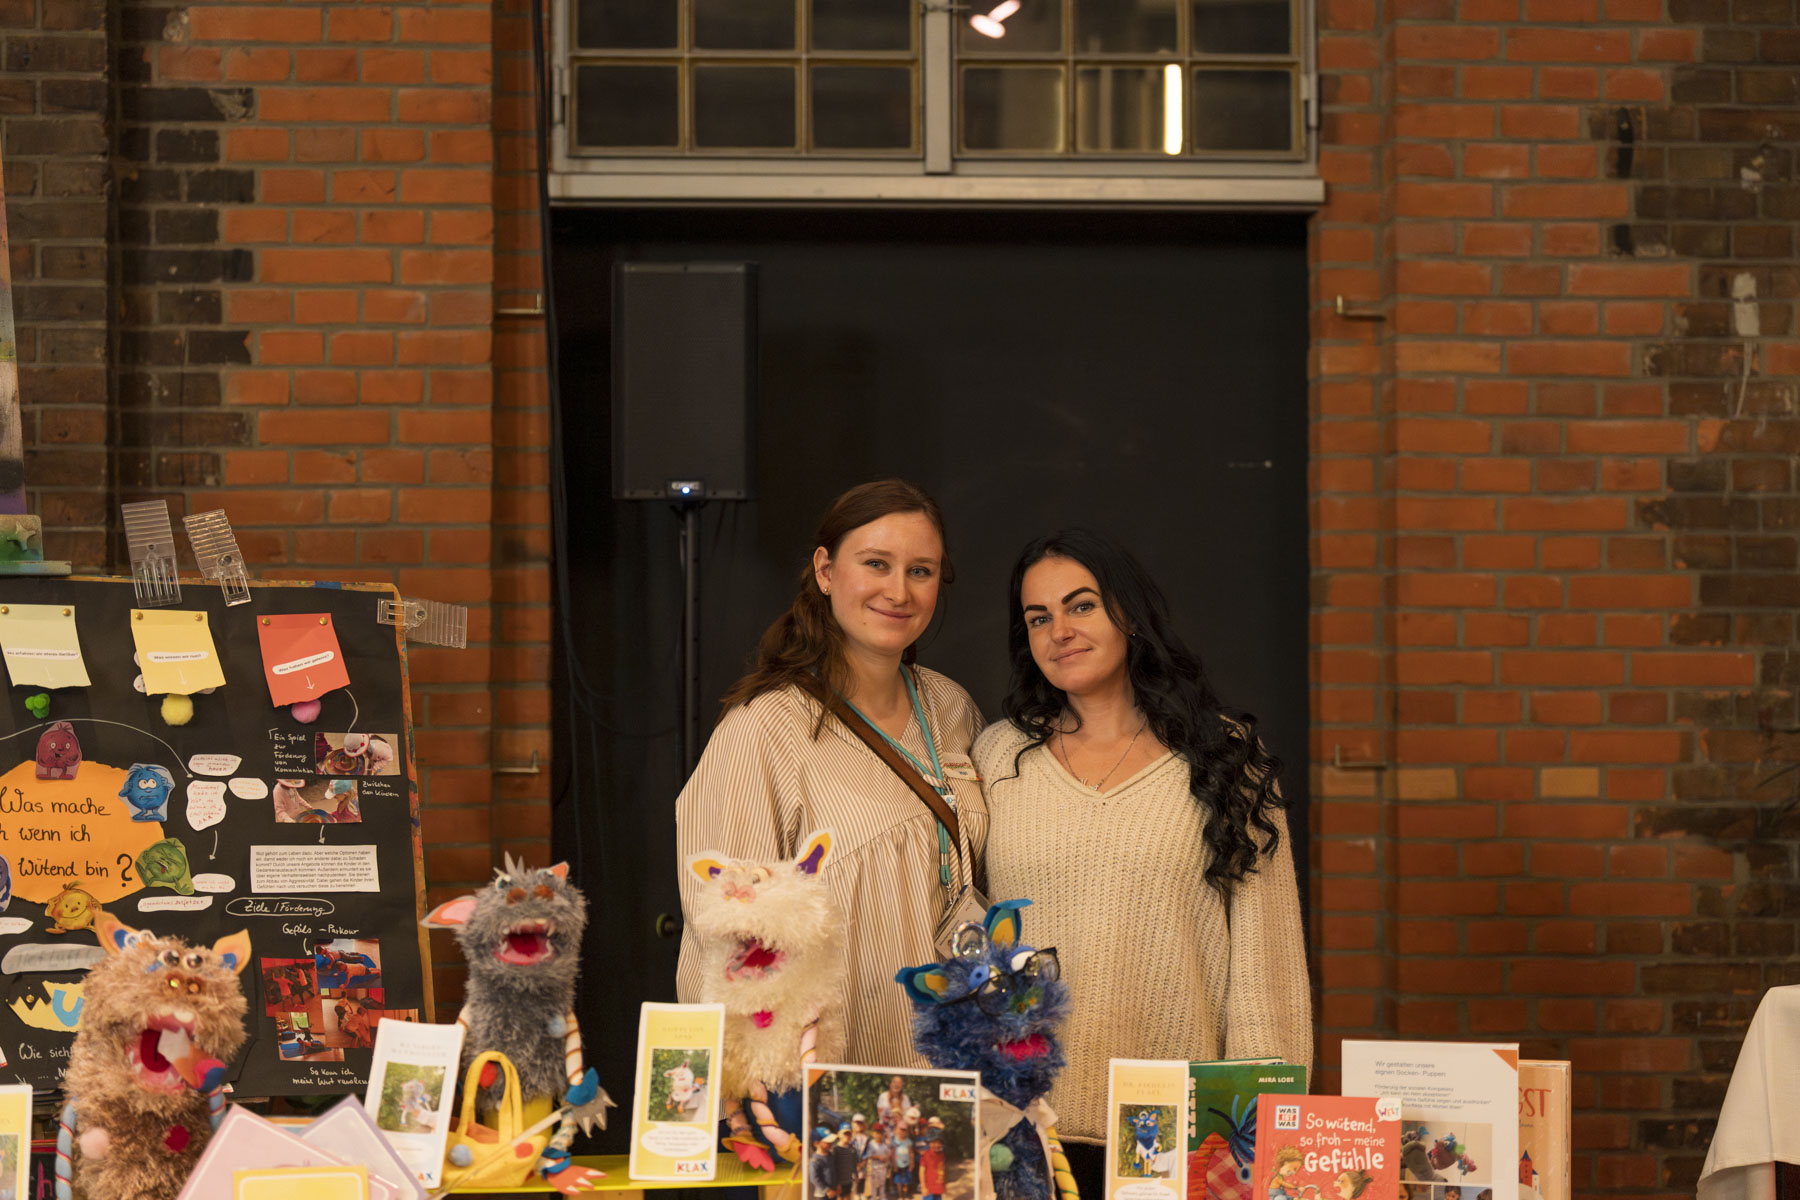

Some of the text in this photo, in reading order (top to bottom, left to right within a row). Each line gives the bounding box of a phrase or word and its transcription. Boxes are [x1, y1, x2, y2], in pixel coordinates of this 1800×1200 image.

[287, 733, 306, 744] Spiel
[0, 786, 112, 816] Was mache
[18, 827, 61, 842] wenn
[70, 824, 91, 842] ich
[18, 853, 133, 888] Wütend bin ?
[245, 900, 270, 912] Ziele
[18, 1043, 43, 1060] Wie
[309, 1067, 318, 1076] So
[341, 1067, 354, 1075] ich
[317, 1077, 335, 1086] Wut
[944, 1088, 976, 1098] KLAX
[1378, 1108, 1400, 1118] WELT
[1306, 1112, 1376, 1134] So wütend,
[1300, 1136, 1313, 1147] so
[1316, 1132, 1341, 1147] froh
[1354, 1136, 1385, 1147] meine
[1304, 1147, 1384, 1173] Gefühle
[677, 1162, 708, 1173] KLAX
